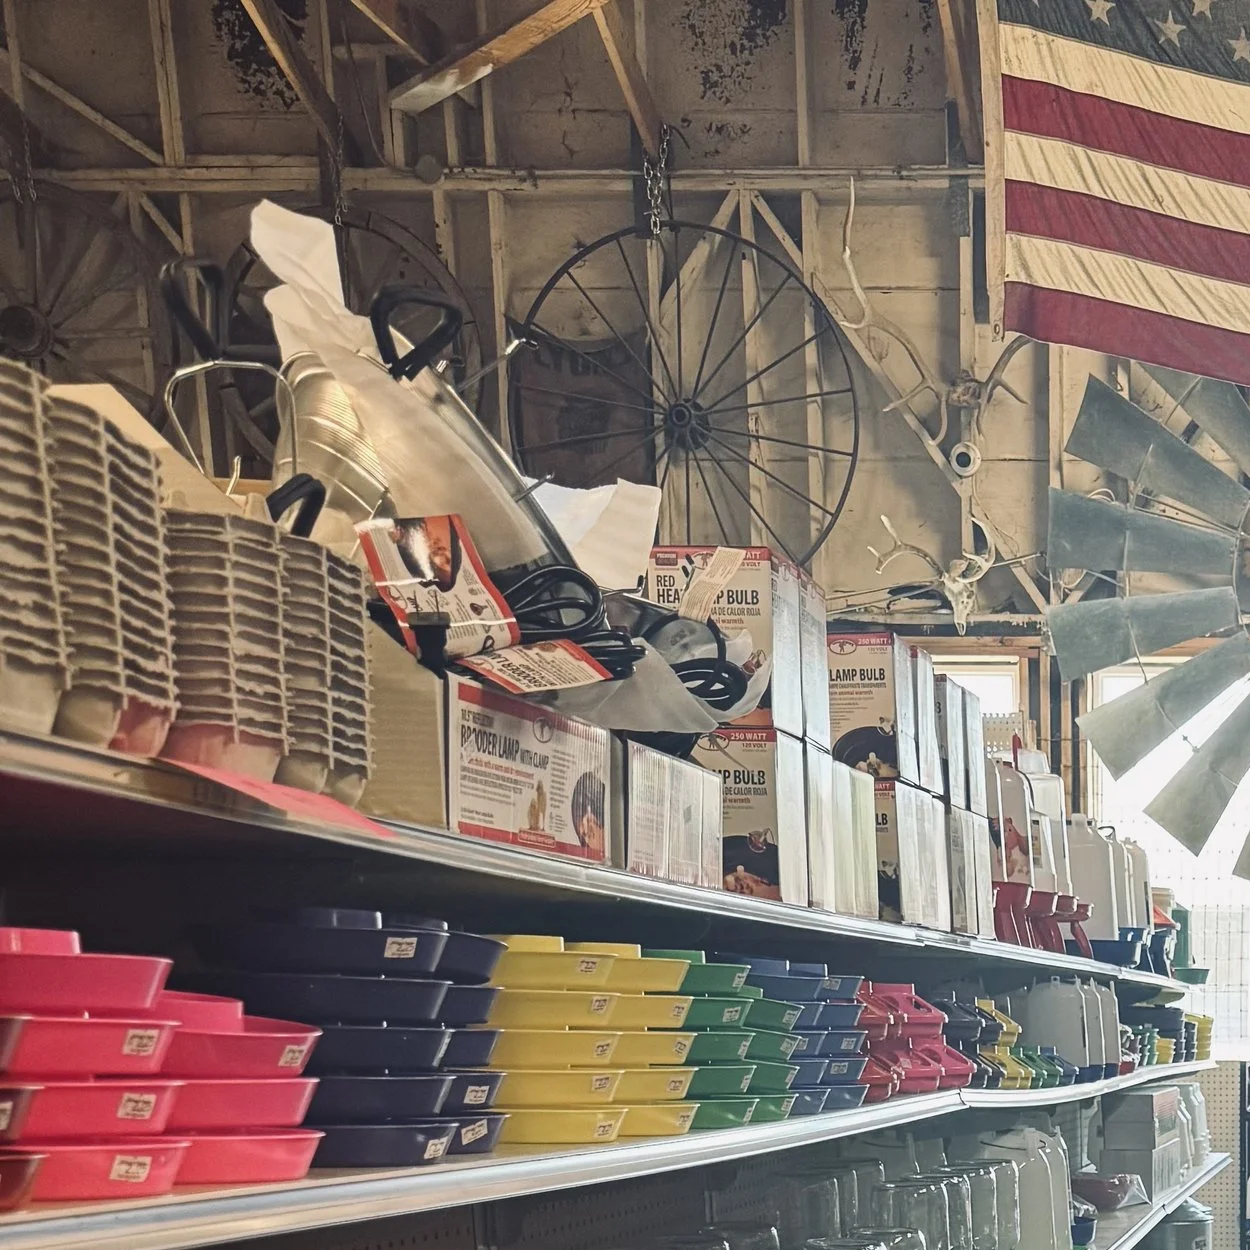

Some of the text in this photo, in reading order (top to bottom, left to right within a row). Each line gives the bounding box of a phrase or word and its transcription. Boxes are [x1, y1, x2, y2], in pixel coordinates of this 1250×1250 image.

[656, 575, 675, 588] RED
[657, 588, 683, 604] HEA
[727, 589, 760, 605] BULB
[726, 606, 746, 616] CALOR
[746, 607, 761, 616] ROJA
[829, 667, 885, 682] LAMP BULB
[730, 732, 767, 741] 250 WATT
[498, 736, 520, 762] LAMP
[533, 751, 550, 770] CLAMP
[733, 769, 766, 785] BULB
[725, 786, 733, 796] DE
[733, 786, 753, 796] CALOR
[876, 813, 889, 826] LB
